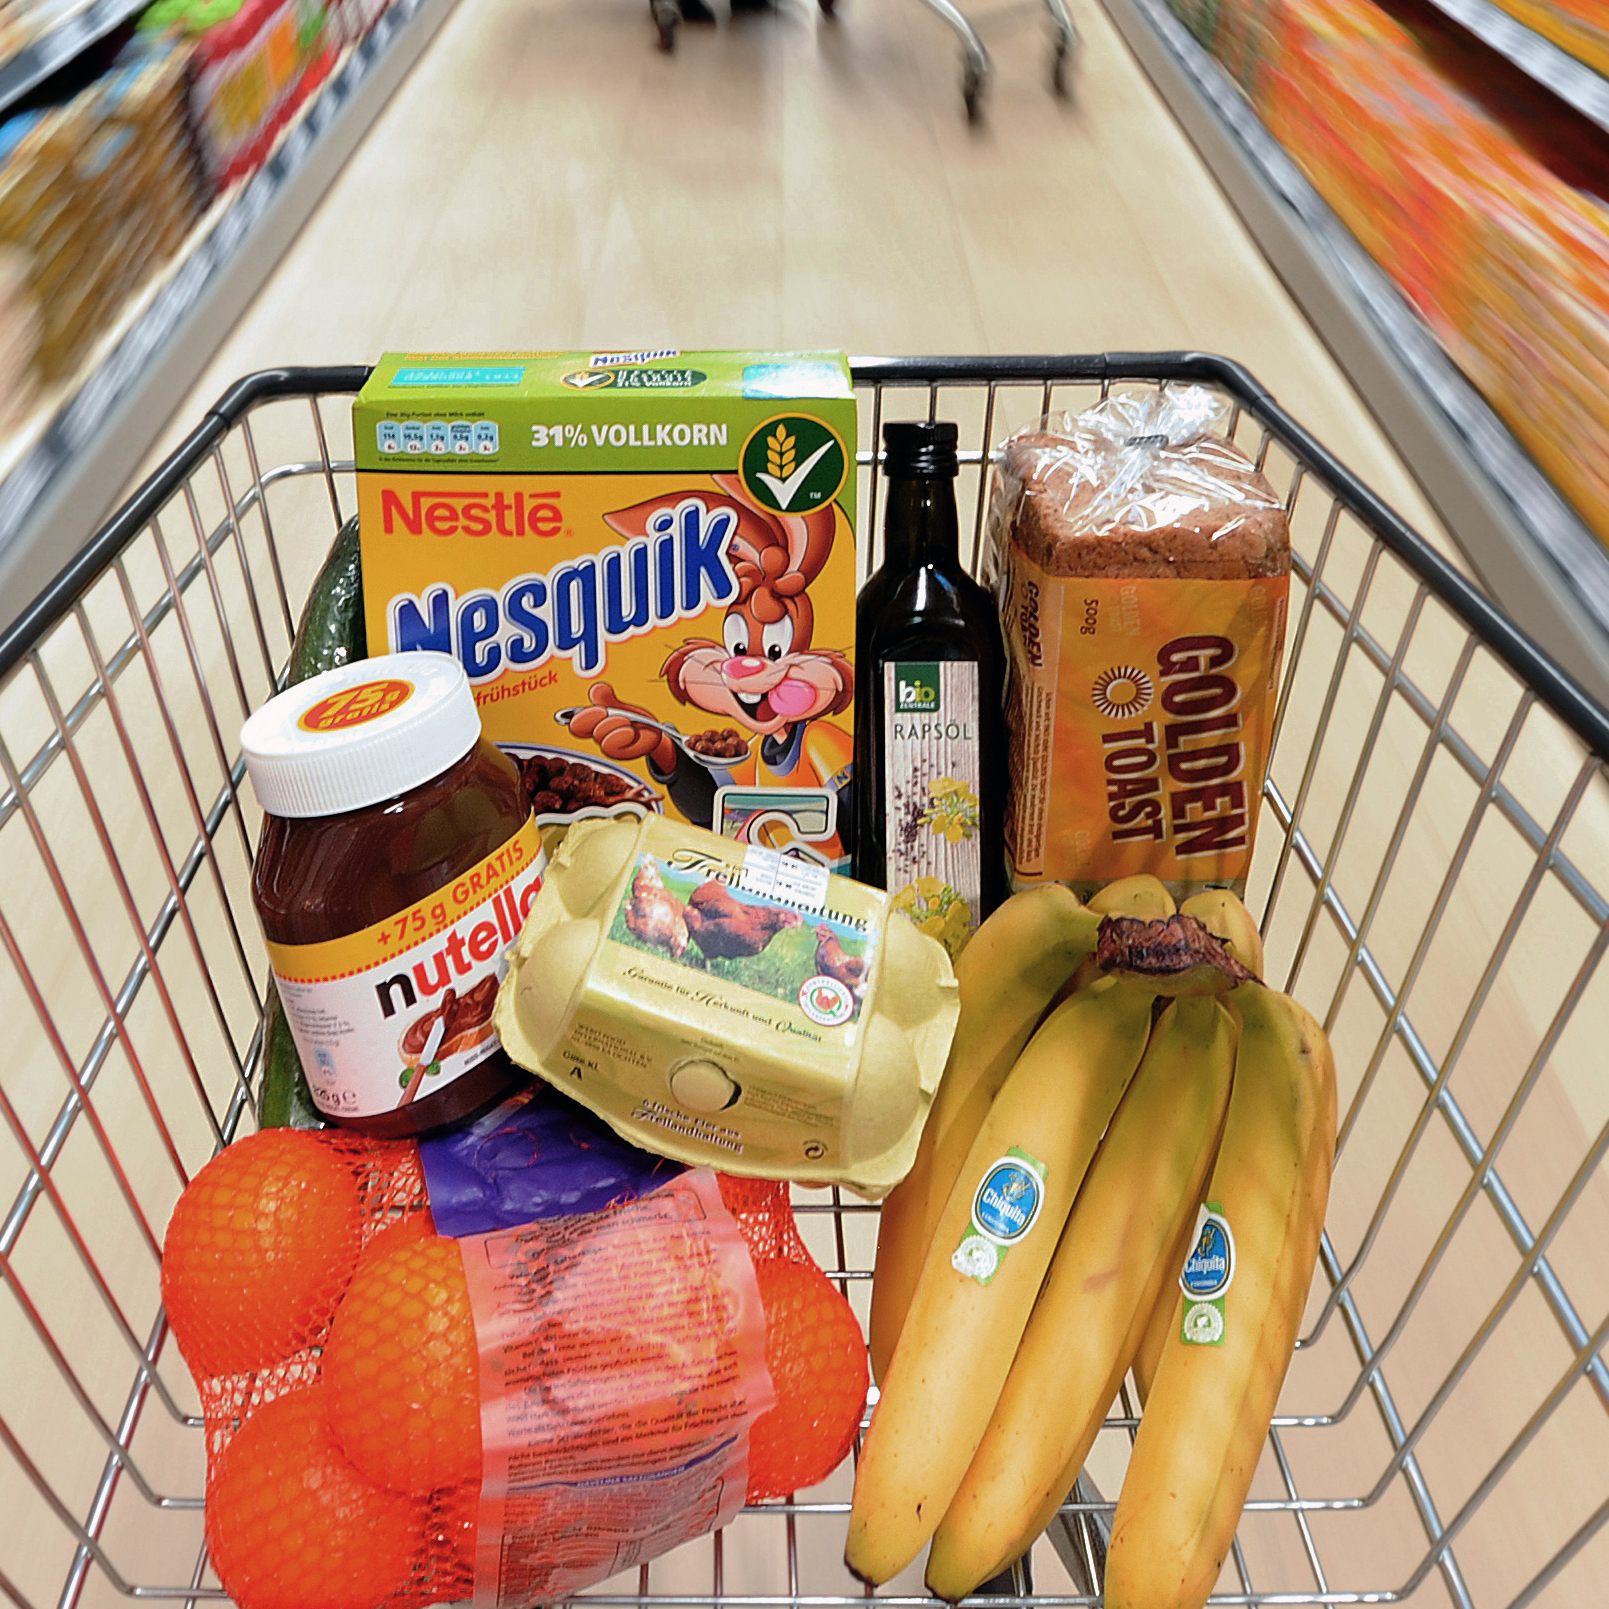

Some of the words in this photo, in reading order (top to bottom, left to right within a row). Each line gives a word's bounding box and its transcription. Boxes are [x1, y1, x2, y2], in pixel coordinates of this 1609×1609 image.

[531, 423, 588, 448] 31%
[591, 423, 728, 447] VOLLKORN
[381, 489, 564, 537] Nestlé
[391, 501, 734, 679] Nesquik
[1028, 580, 1043, 668] GOLDEN
[1080, 598, 1099, 636] 500g
[475, 671, 558, 707] frühstück
[899, 680, 935, 702] bio
[894, 719, 972, 740] RAPSÖL
[1157, 634, 1249, 857] GOLDEN
[1101, 721, 1166, 843] TOAST
[451, 838, 524, 905] GRATIS
[623, 966, 673, 991] Garantie
[675, 984, 690, 996] für
[690, 988, 750, 1018] Herkunft
[752, 1012, 773, 1026] und
[775, 1019, 822, 1044] Qualität
[983, 1187, 1027, 1227] Chiquita
[1185, 1254, 1225, 1275] Chiquita
